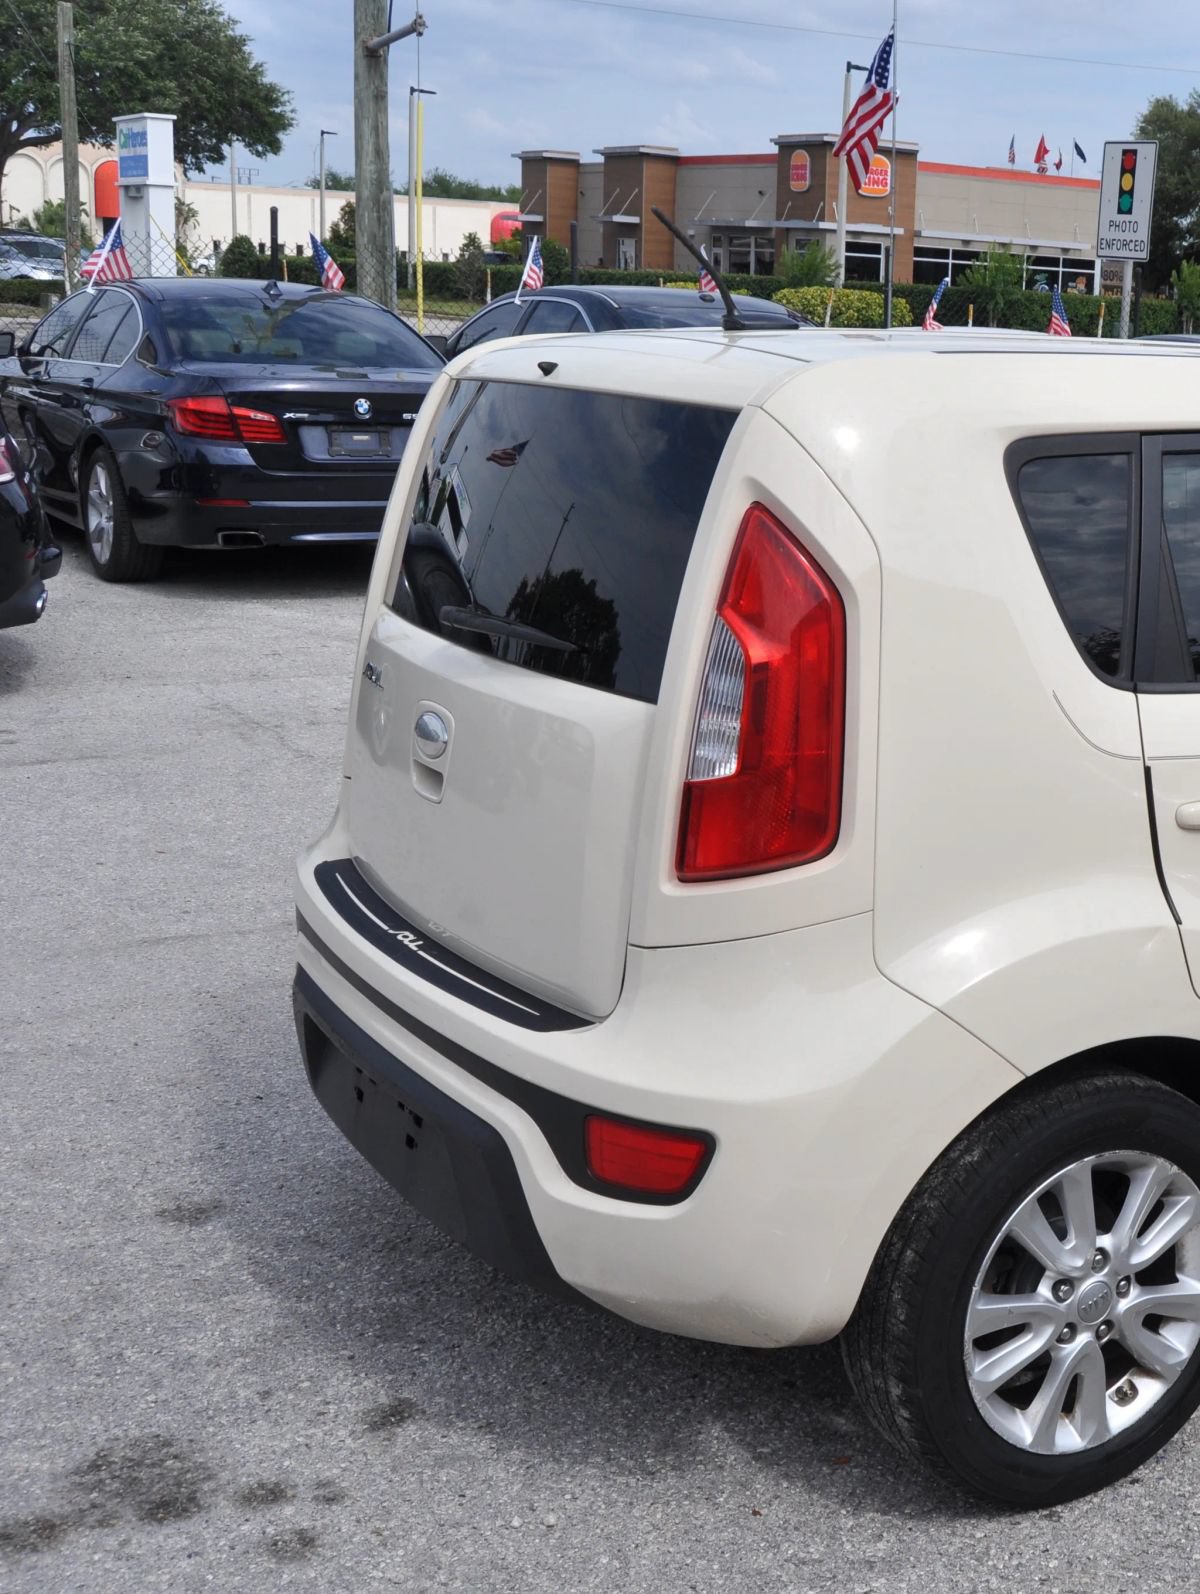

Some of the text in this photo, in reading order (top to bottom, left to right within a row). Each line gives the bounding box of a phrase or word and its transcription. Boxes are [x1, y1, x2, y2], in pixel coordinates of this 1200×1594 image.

[865, 177, 888, 188] ING
[1108, 220, 1138, 234] PHOTO
[1099, 238, 1146, 253] ENFORCED
